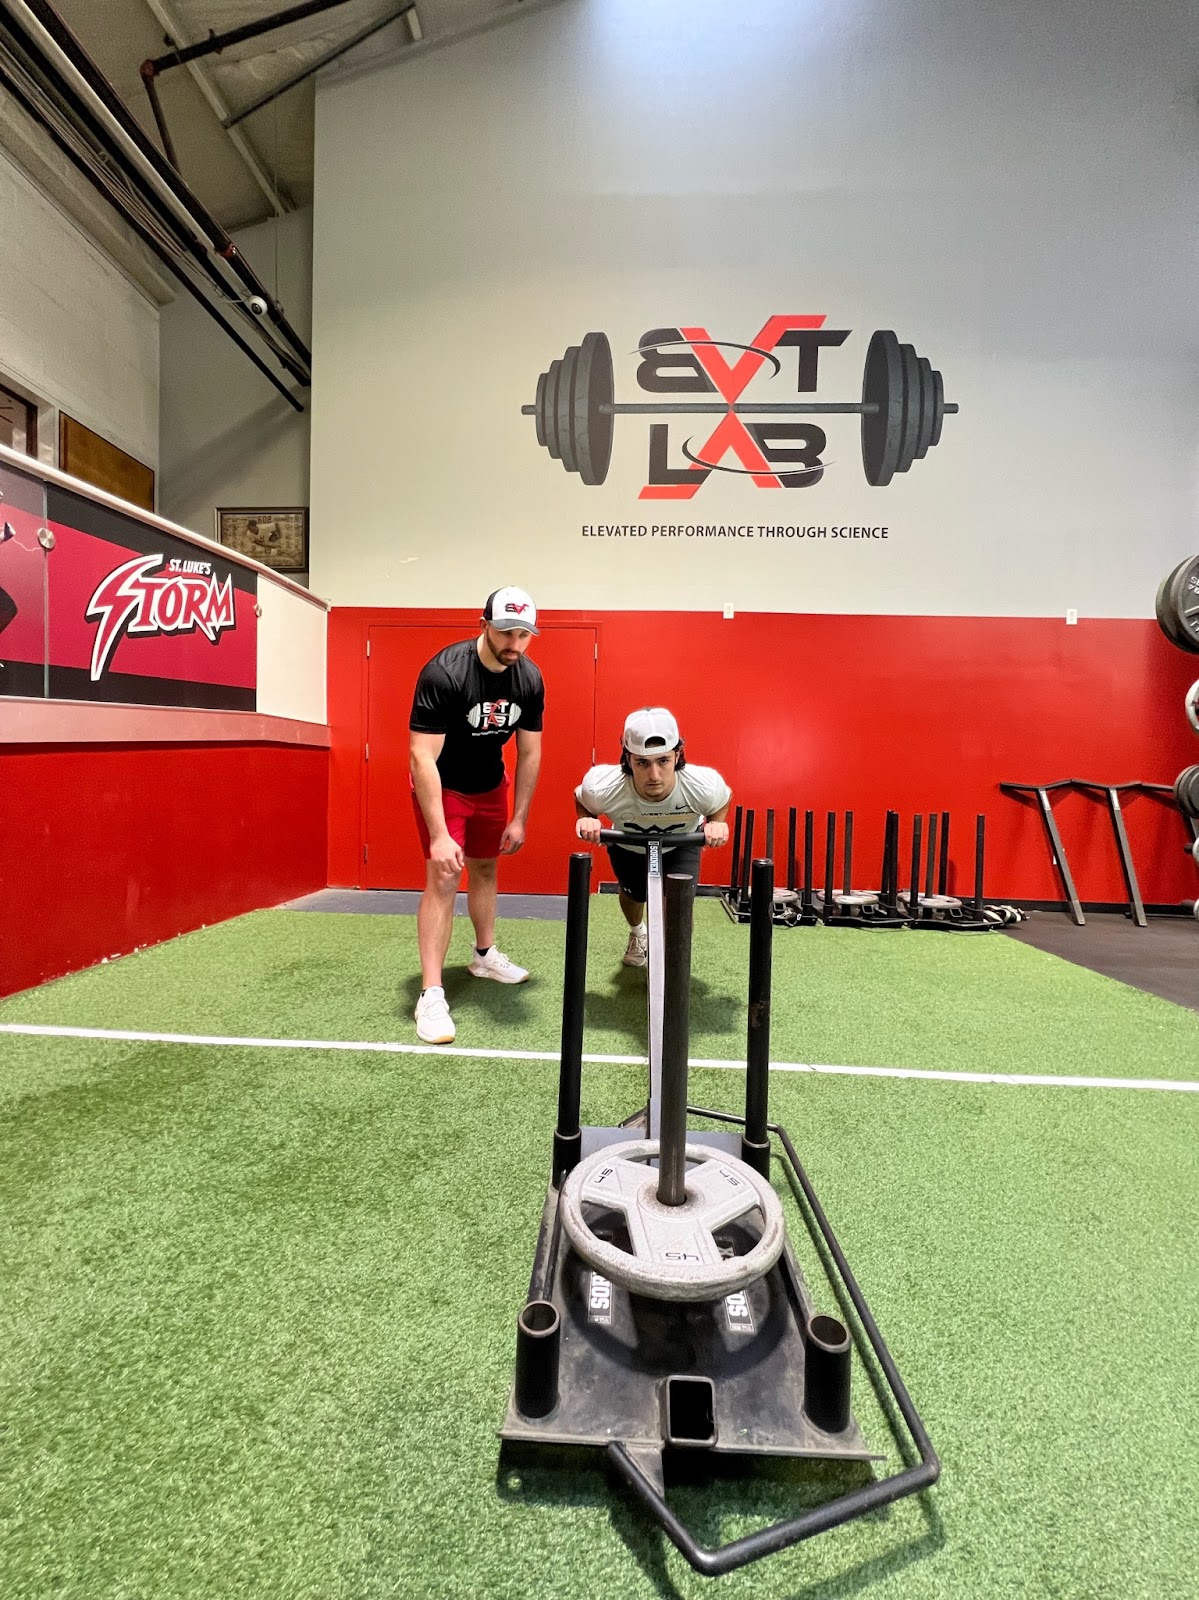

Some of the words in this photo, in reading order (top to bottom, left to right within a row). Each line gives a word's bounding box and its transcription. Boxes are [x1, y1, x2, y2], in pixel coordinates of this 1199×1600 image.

[637, 408, 826, 499] LAB
[582, 525, 648, 537] ELEVATED
[651, 525, 754, 538] PERFORMANCE
[757, 526, 827, 538] THROUGH
[831, 527, 889, 539] SCIENCE
[169, 558, 182, 572] ST.
[183, 560, 212, 575] LUKE'S
[86, 553, 235, 681] STORM
[593, 1167, 613, 1184] 45
[719, 1169, 741, 1187] 45
[591, 1271, 610, 1309] SOR
[727, 1291, 748, 1317] SO
